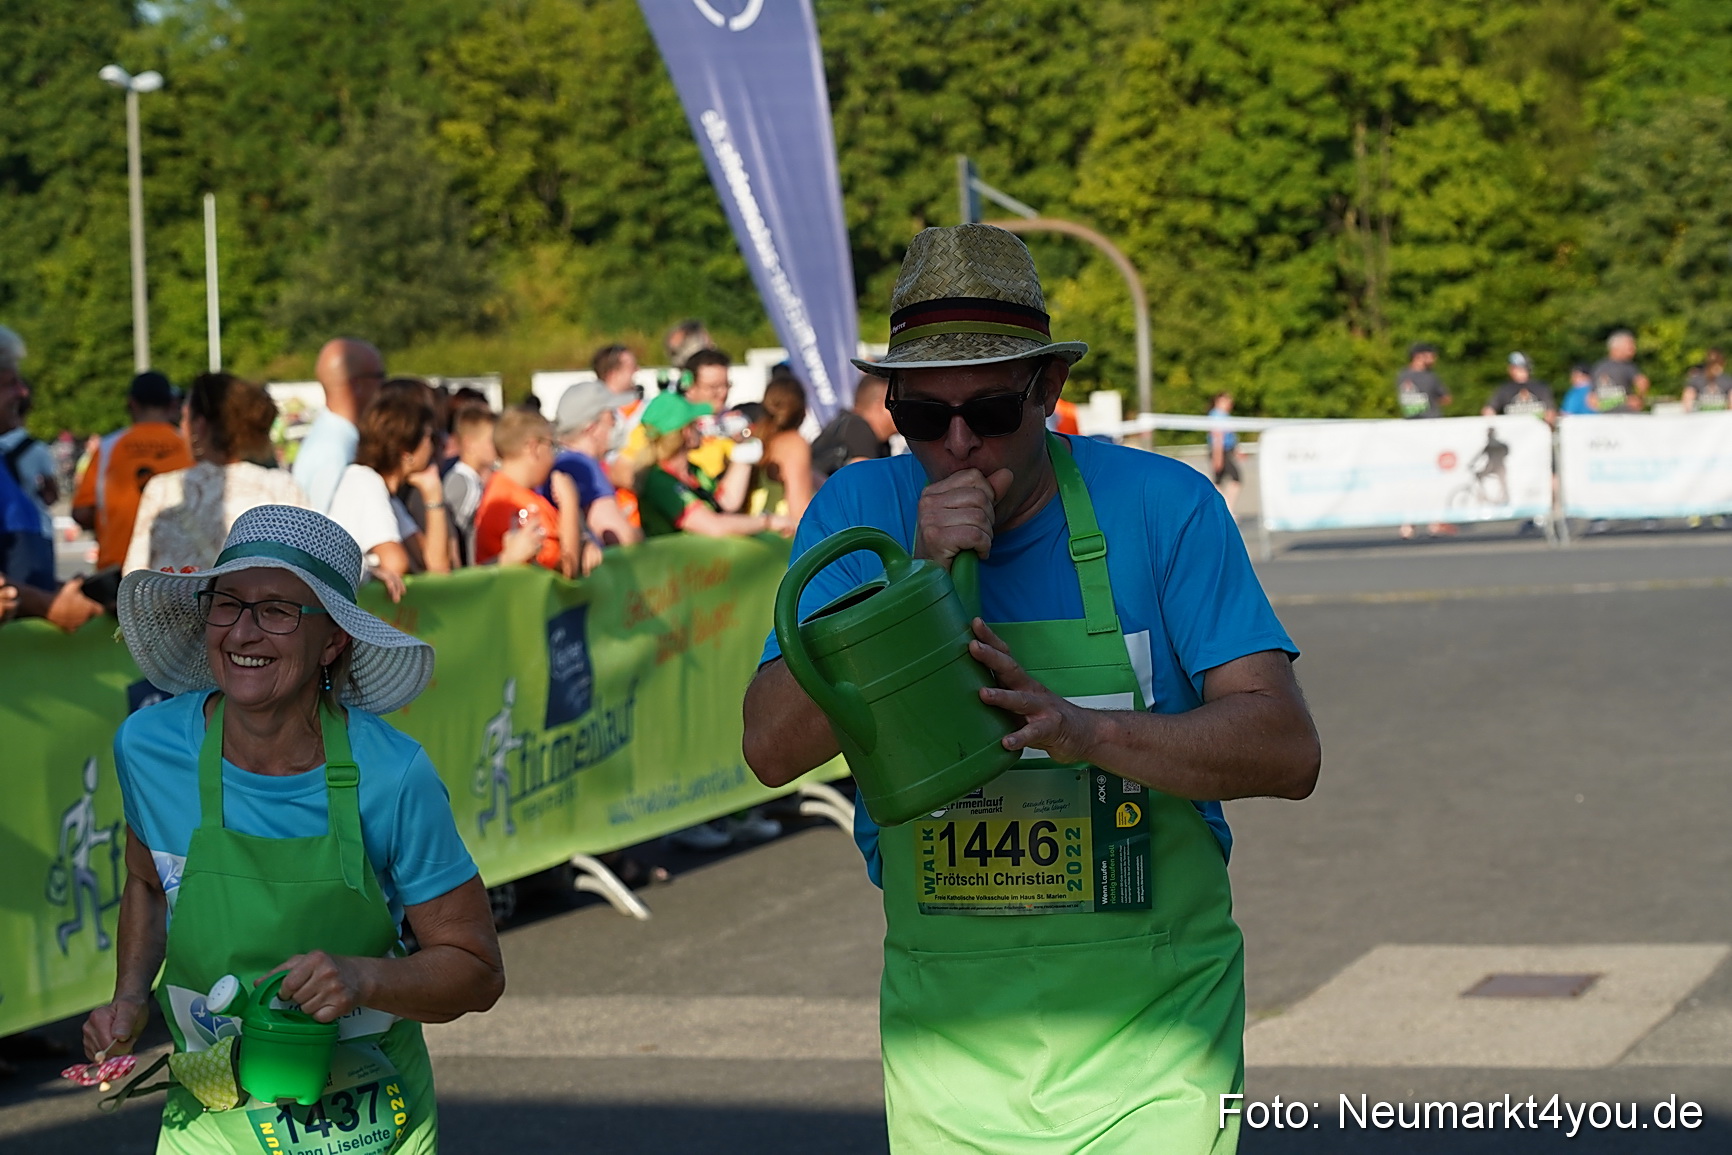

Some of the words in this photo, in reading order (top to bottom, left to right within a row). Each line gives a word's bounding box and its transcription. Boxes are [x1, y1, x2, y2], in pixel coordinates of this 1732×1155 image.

[971, 806, 1003, 815] neumarkt
[1098, 785, 1106, 804] AOK
[922, 828, 936, 895] WALK
[939, 820, 1059, 867] 1446
[1065, 827, 1083, 892] 2022
[935, 873, 989, 886] Frötschl
[993, 872, 1065, 886] Christian
[276, 1082, 379, 1144] 1437
[327, 1128, 391, 1155] Liselotte
